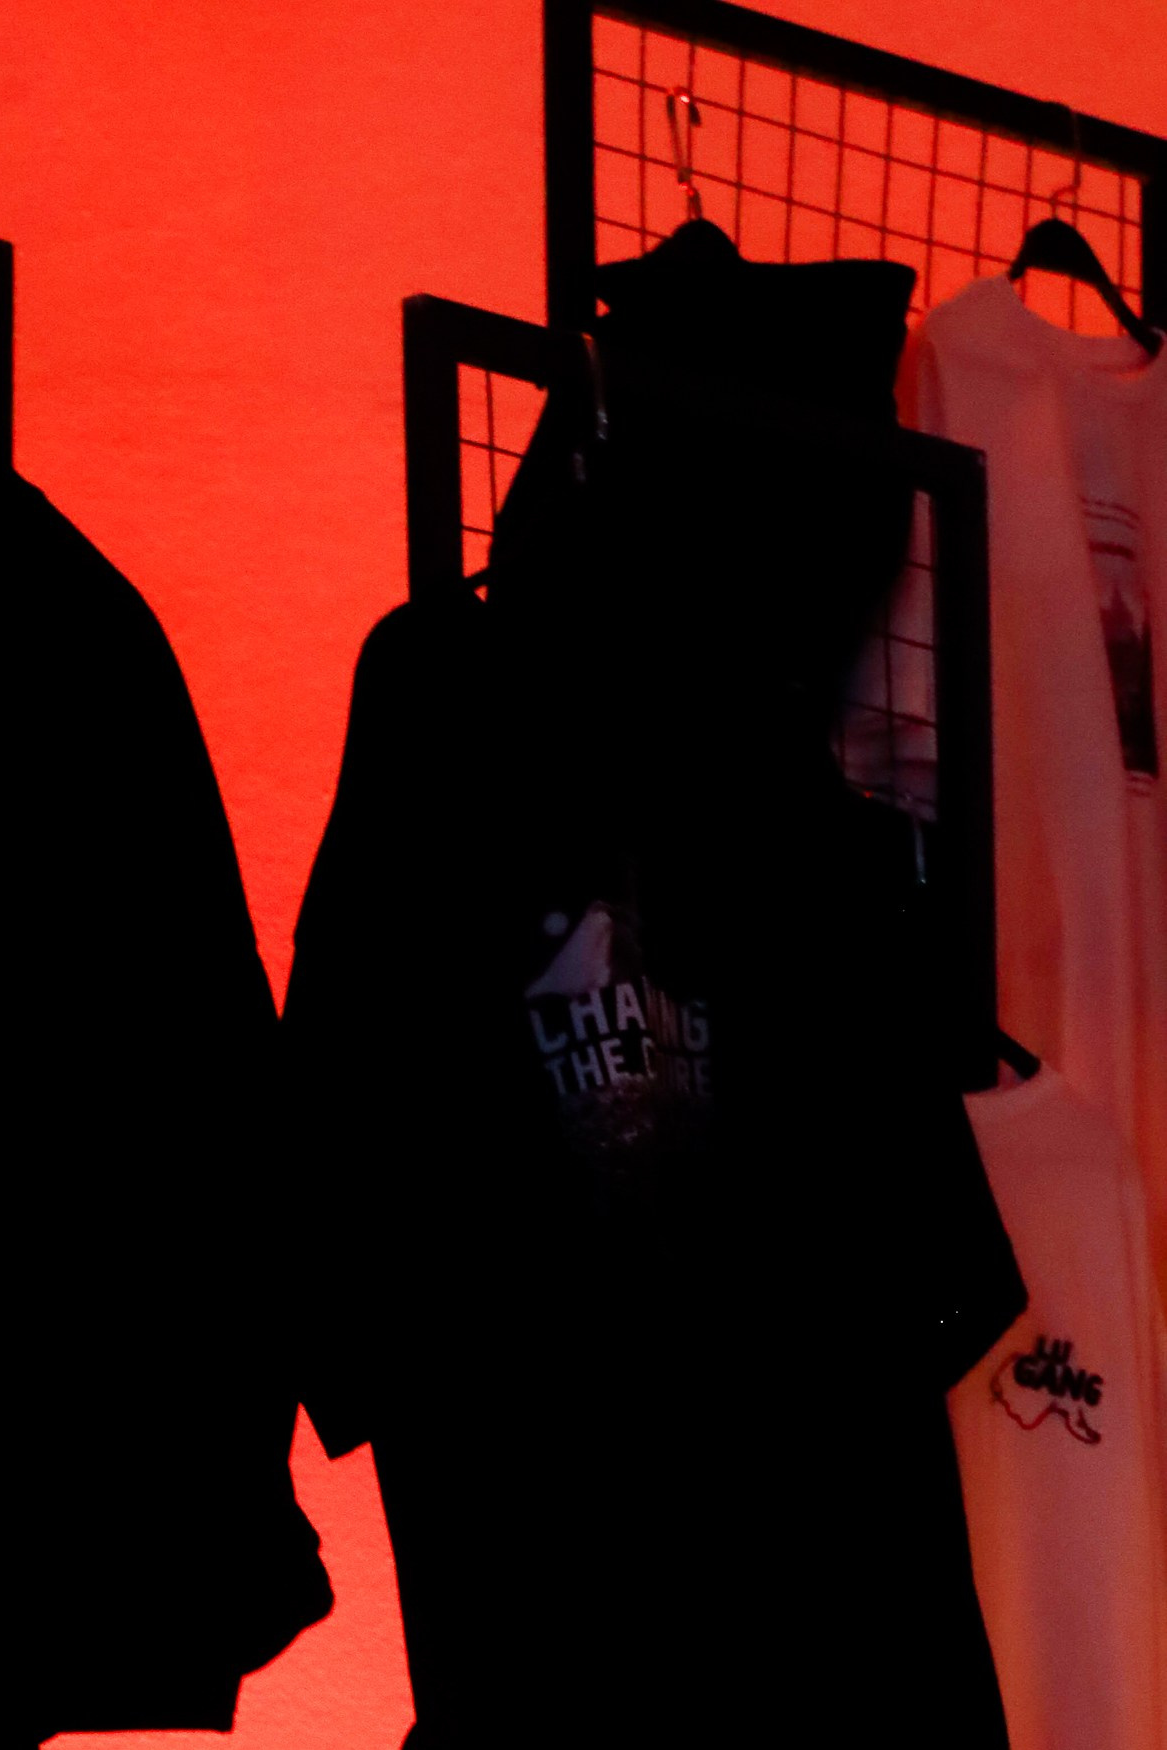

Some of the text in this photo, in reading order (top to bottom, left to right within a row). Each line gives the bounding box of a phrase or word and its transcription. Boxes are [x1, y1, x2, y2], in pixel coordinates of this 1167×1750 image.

[544, 1037, 628, 1096] THE
[1037, 1334, 1073, 1363] LU
[1015, 1355, 1104, 1406] GANG
